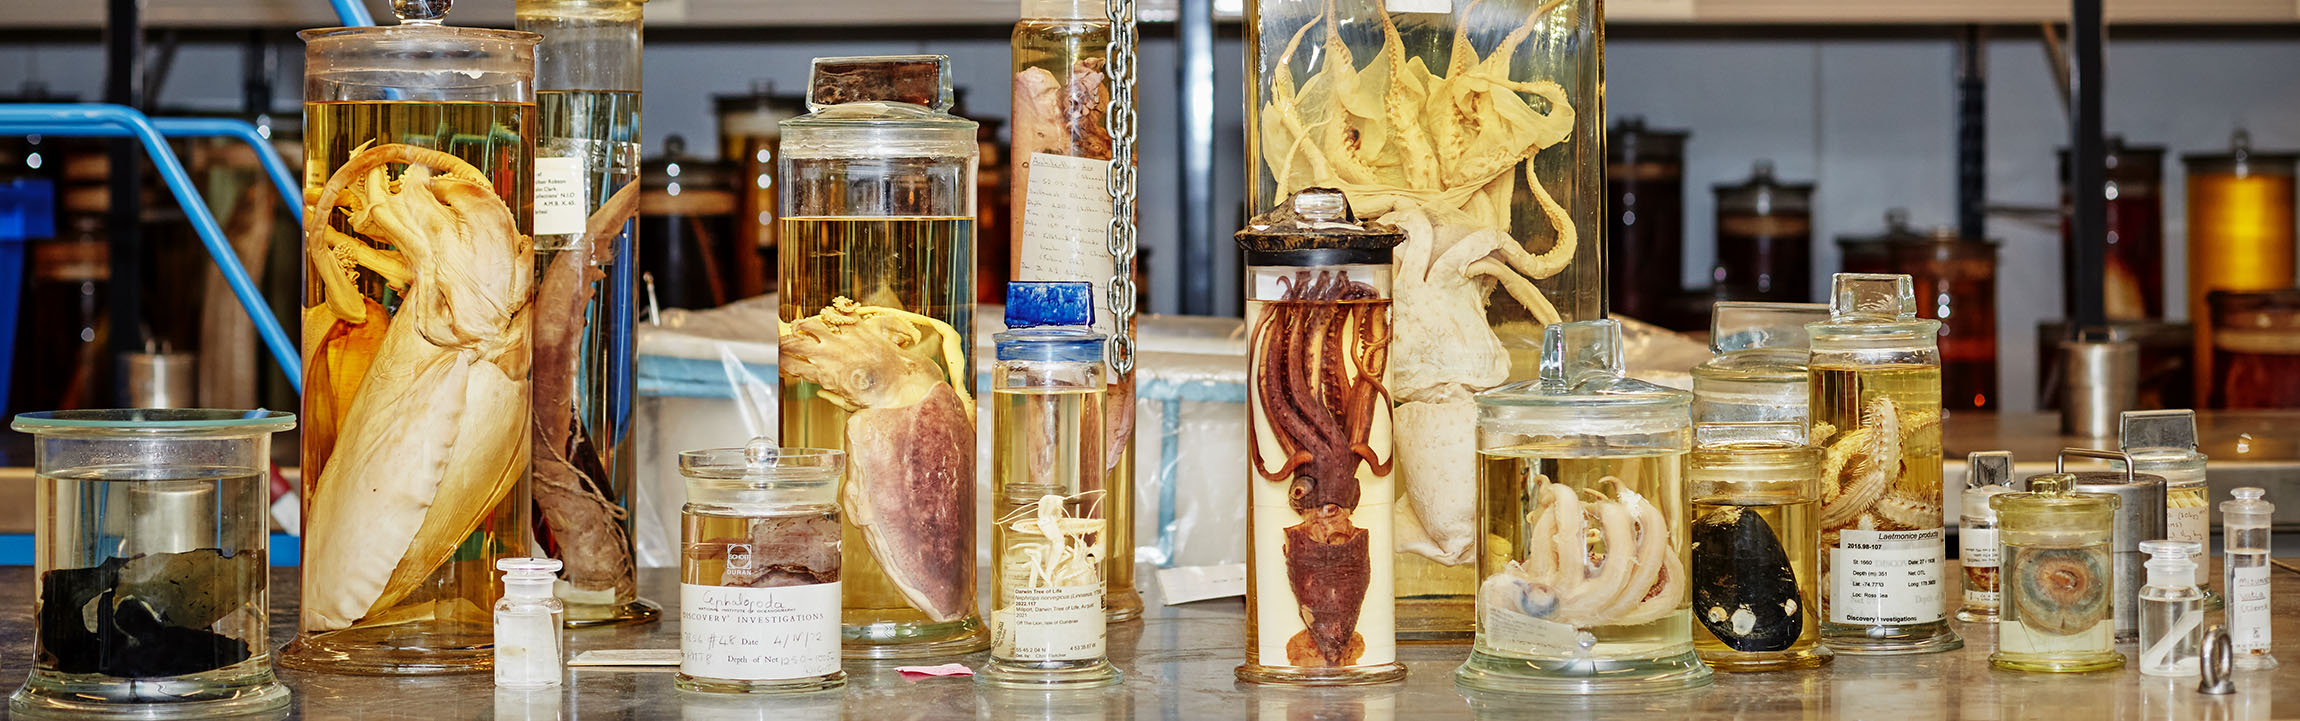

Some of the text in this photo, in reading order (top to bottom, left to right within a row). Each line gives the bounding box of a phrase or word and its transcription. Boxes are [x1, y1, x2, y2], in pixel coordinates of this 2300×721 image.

[703, 590, 784, 613] Cephalopoda
[737, 613, 824, 624] INVESTIGATIONS
[1846, 614, 1876, 622] Discovery
[727, 655, 748, 664] Depth
